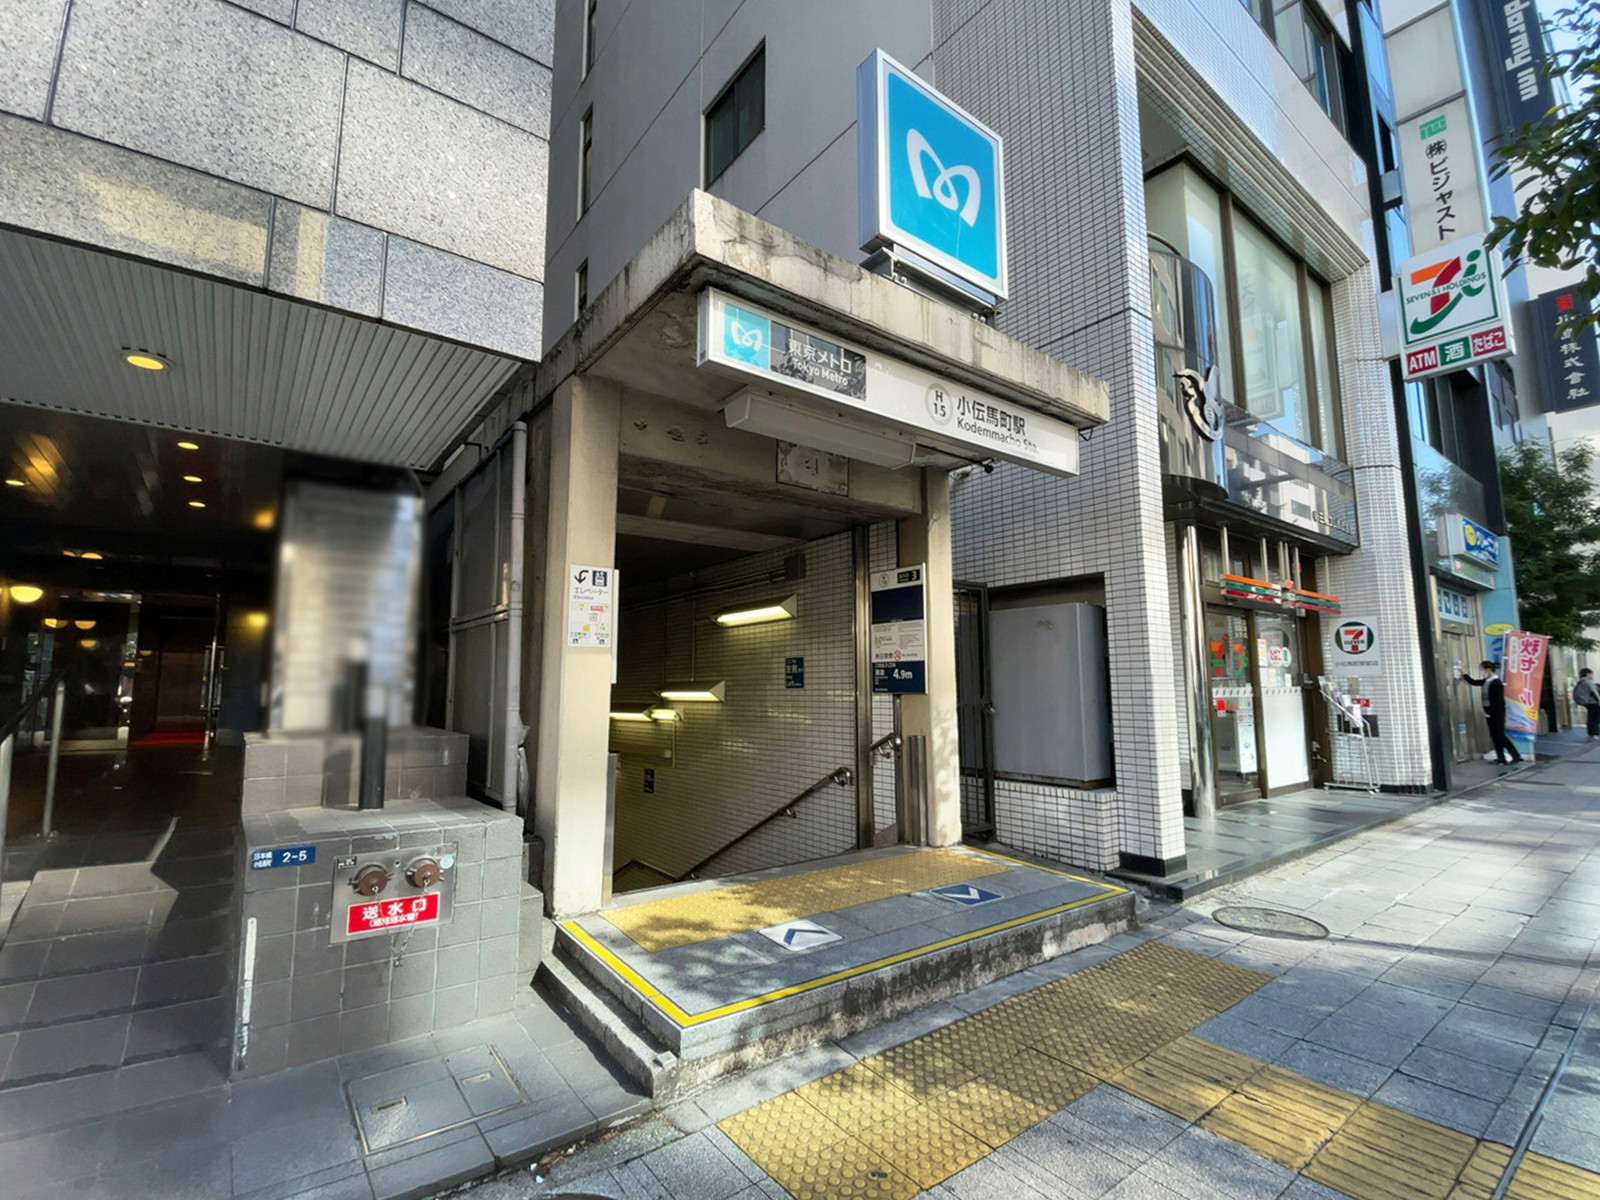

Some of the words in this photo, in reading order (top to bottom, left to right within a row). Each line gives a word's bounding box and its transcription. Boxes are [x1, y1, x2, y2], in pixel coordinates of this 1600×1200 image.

[1517, 66, 1539, 101] inn
[1444, 341, 1465, 362] 酒
[1473, 331, 1505, 354] たばこ
[788, 339, 852, 374] 東京メトロ
[1409, 350, 1437, 373] ATM
[792, 357, 820, 377] Tokyo
[821, 368, 849, 386] Metro
[935, 390, 944, 402] H
[933, 402, 946, 418] 15
[957, 395, 1026, 436] 小伝馬町駅
[957, 416, 1021, 447] Kodemmacho
[911, 570, 917, 582] 3
[892, 668, 914, 680] 4.9m
